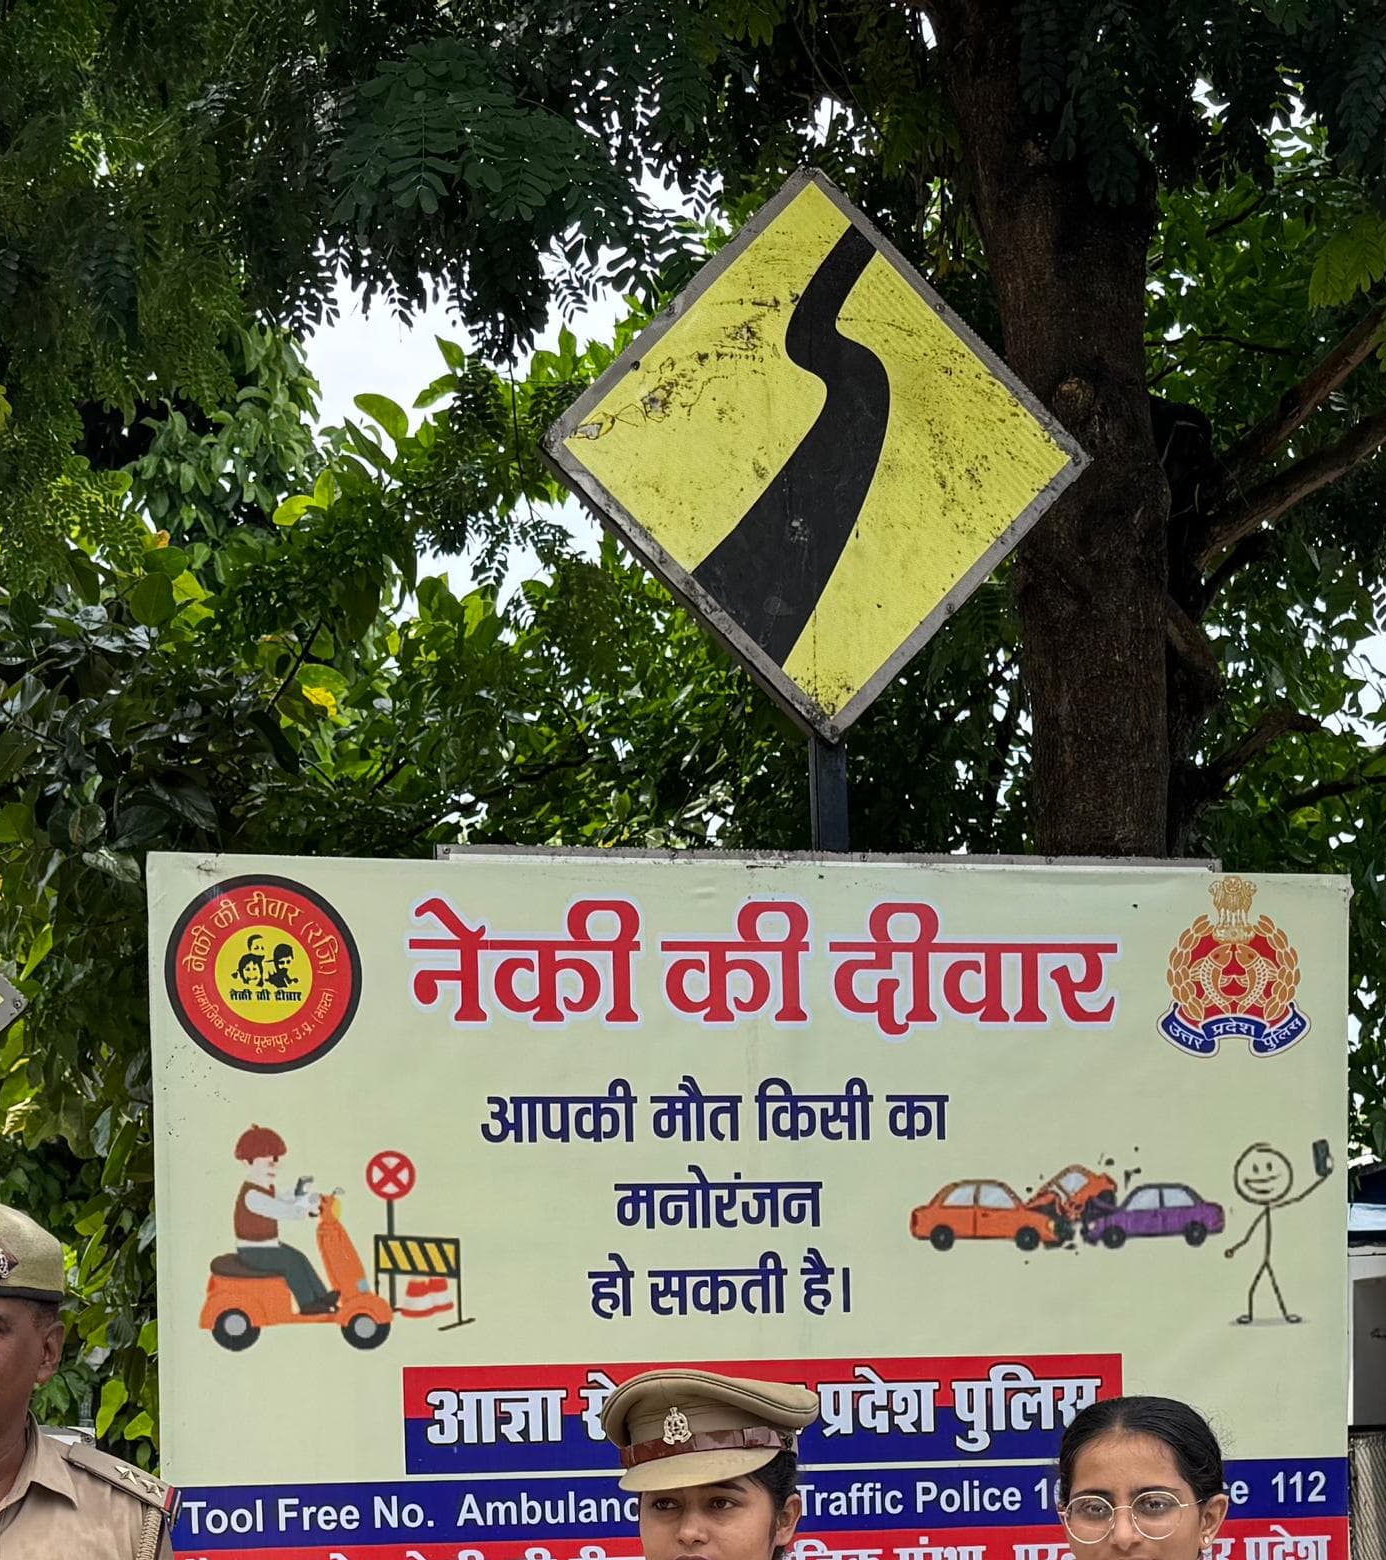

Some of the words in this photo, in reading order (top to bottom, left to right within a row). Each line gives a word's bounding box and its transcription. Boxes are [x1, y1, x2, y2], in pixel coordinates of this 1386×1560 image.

[182, 924, 216, 973] नेकी
[210, 899, 240, 928] की
[244, 891, 305, 926] दीवार
[408, 897, 641, 1023] नेकी
[660, 900, 810, 1023] की
[828, 902, 1119, 1036] दीवार
[1169, 1021, 1204, 1049] उत्तर
[1211, 1018, 1255, 1036] प्रदेश
[1262, 1018, 1302, 1051] पुलिस
[481, 1078, 637, 1143] आपकी
[650, 1075, 742, 1142] मौत
[755, 1077, 873, 1141] किसी
[886, 1094, 949, 1141] का
[614, 1165, 823, 1229] मनोरंजन
[588, 1253, 635, 1319] हो
[648, 1251, 787, 1315] सकती
[426, 1389, 567, 1444] आज्ञा
[818, 1367, 939, 1437] प्रदेश
[952, 1363, 1102, 1452] पुलिस
[182, 1499, 263, 1534] Tool
[278, 1498, 360, 1532] Free
[374, 1494, 435, 1529] No.
[457, 1491, 639, 1528] Ambulanc
[795, 1482, 904, 1517] Traffic
[916, 1479, 1021, 1514] Police
[1271, 1471, 1326, 1503] 112
